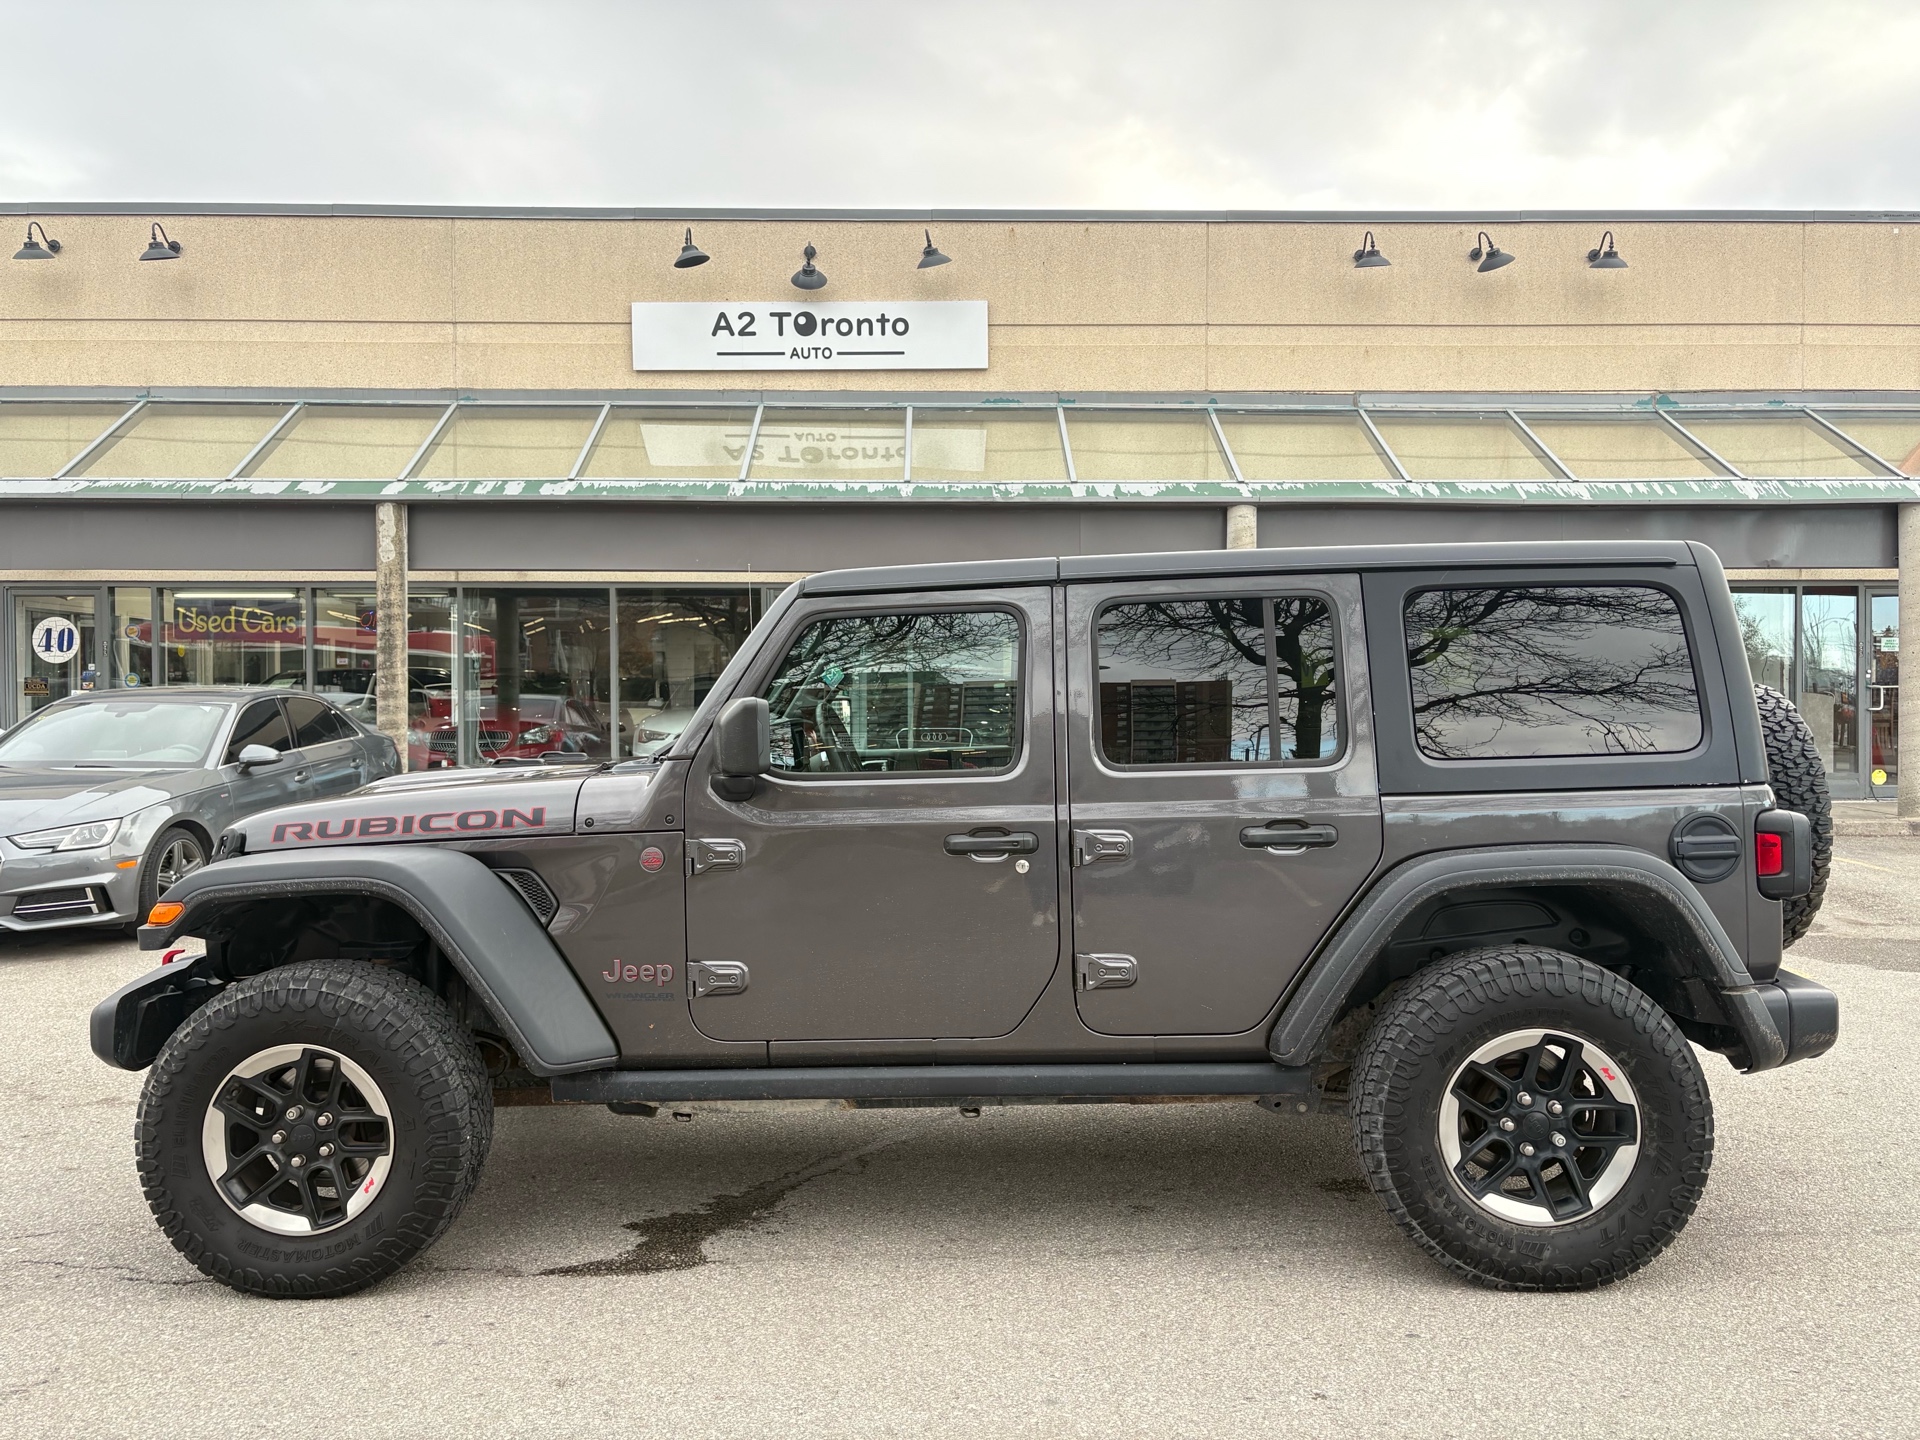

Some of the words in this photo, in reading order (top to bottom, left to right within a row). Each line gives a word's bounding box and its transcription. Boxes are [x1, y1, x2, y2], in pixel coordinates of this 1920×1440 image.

[711, 311, 757, 337] A2
[790, 347, 833, 360] AUTO
[176, 606, 237, 633] Used
[242, 606, 297, 634] Cars
[37, 627, 74, 653] 40
[270, 806, 547, 844] RUBICON
[602, 959, 674, 987] Jeep
[1420, 1152, 1515, 1250] MOTOMASTER
[237, 1233, 362, 1264] MOTOMASTER
